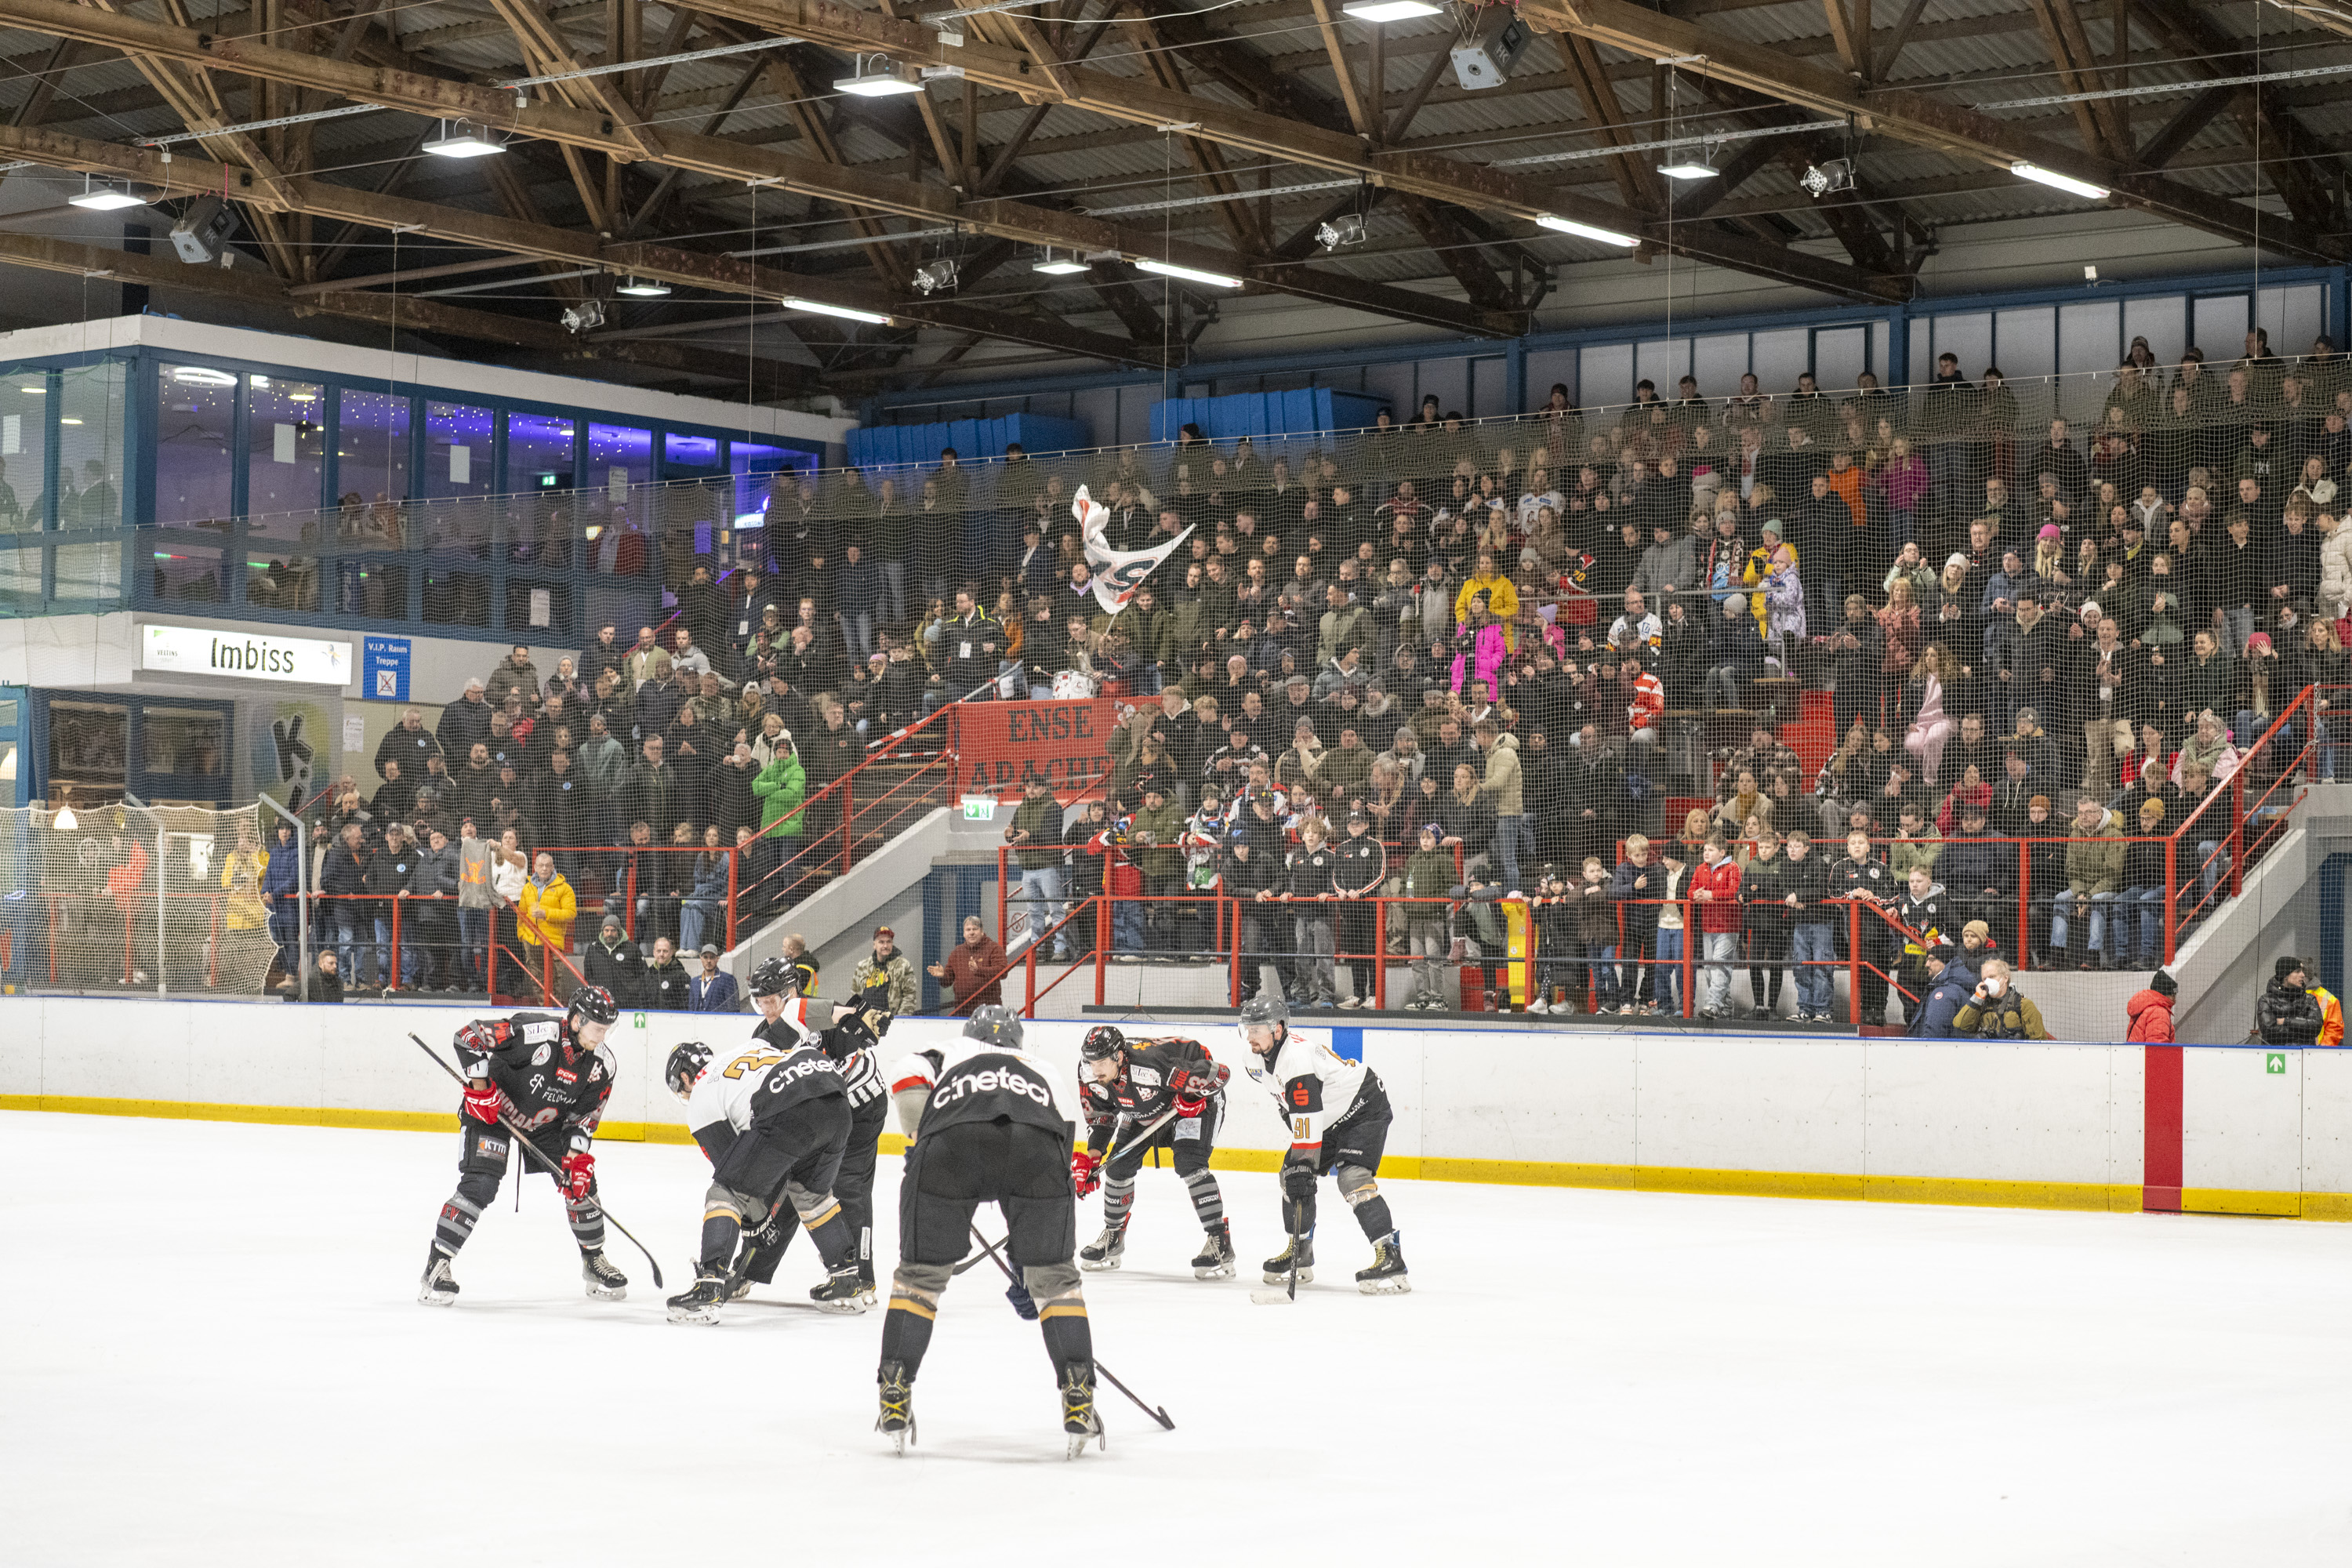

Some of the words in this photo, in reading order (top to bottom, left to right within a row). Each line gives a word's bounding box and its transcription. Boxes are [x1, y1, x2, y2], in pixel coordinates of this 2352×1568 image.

[211, 637, 294, 673] Imbiss
[368, 643, 387, 652] V.I.P.
[389, 644, 408, 653] Raum
[376, 656, 398, 667] Treppe
[1008, 706, 1094, 742] ENSE
[993, 1025, 1000, 1034] 7
[1294, 1117, 1310, 1139] 91
[485, 1139, 506, 1155] KTM
